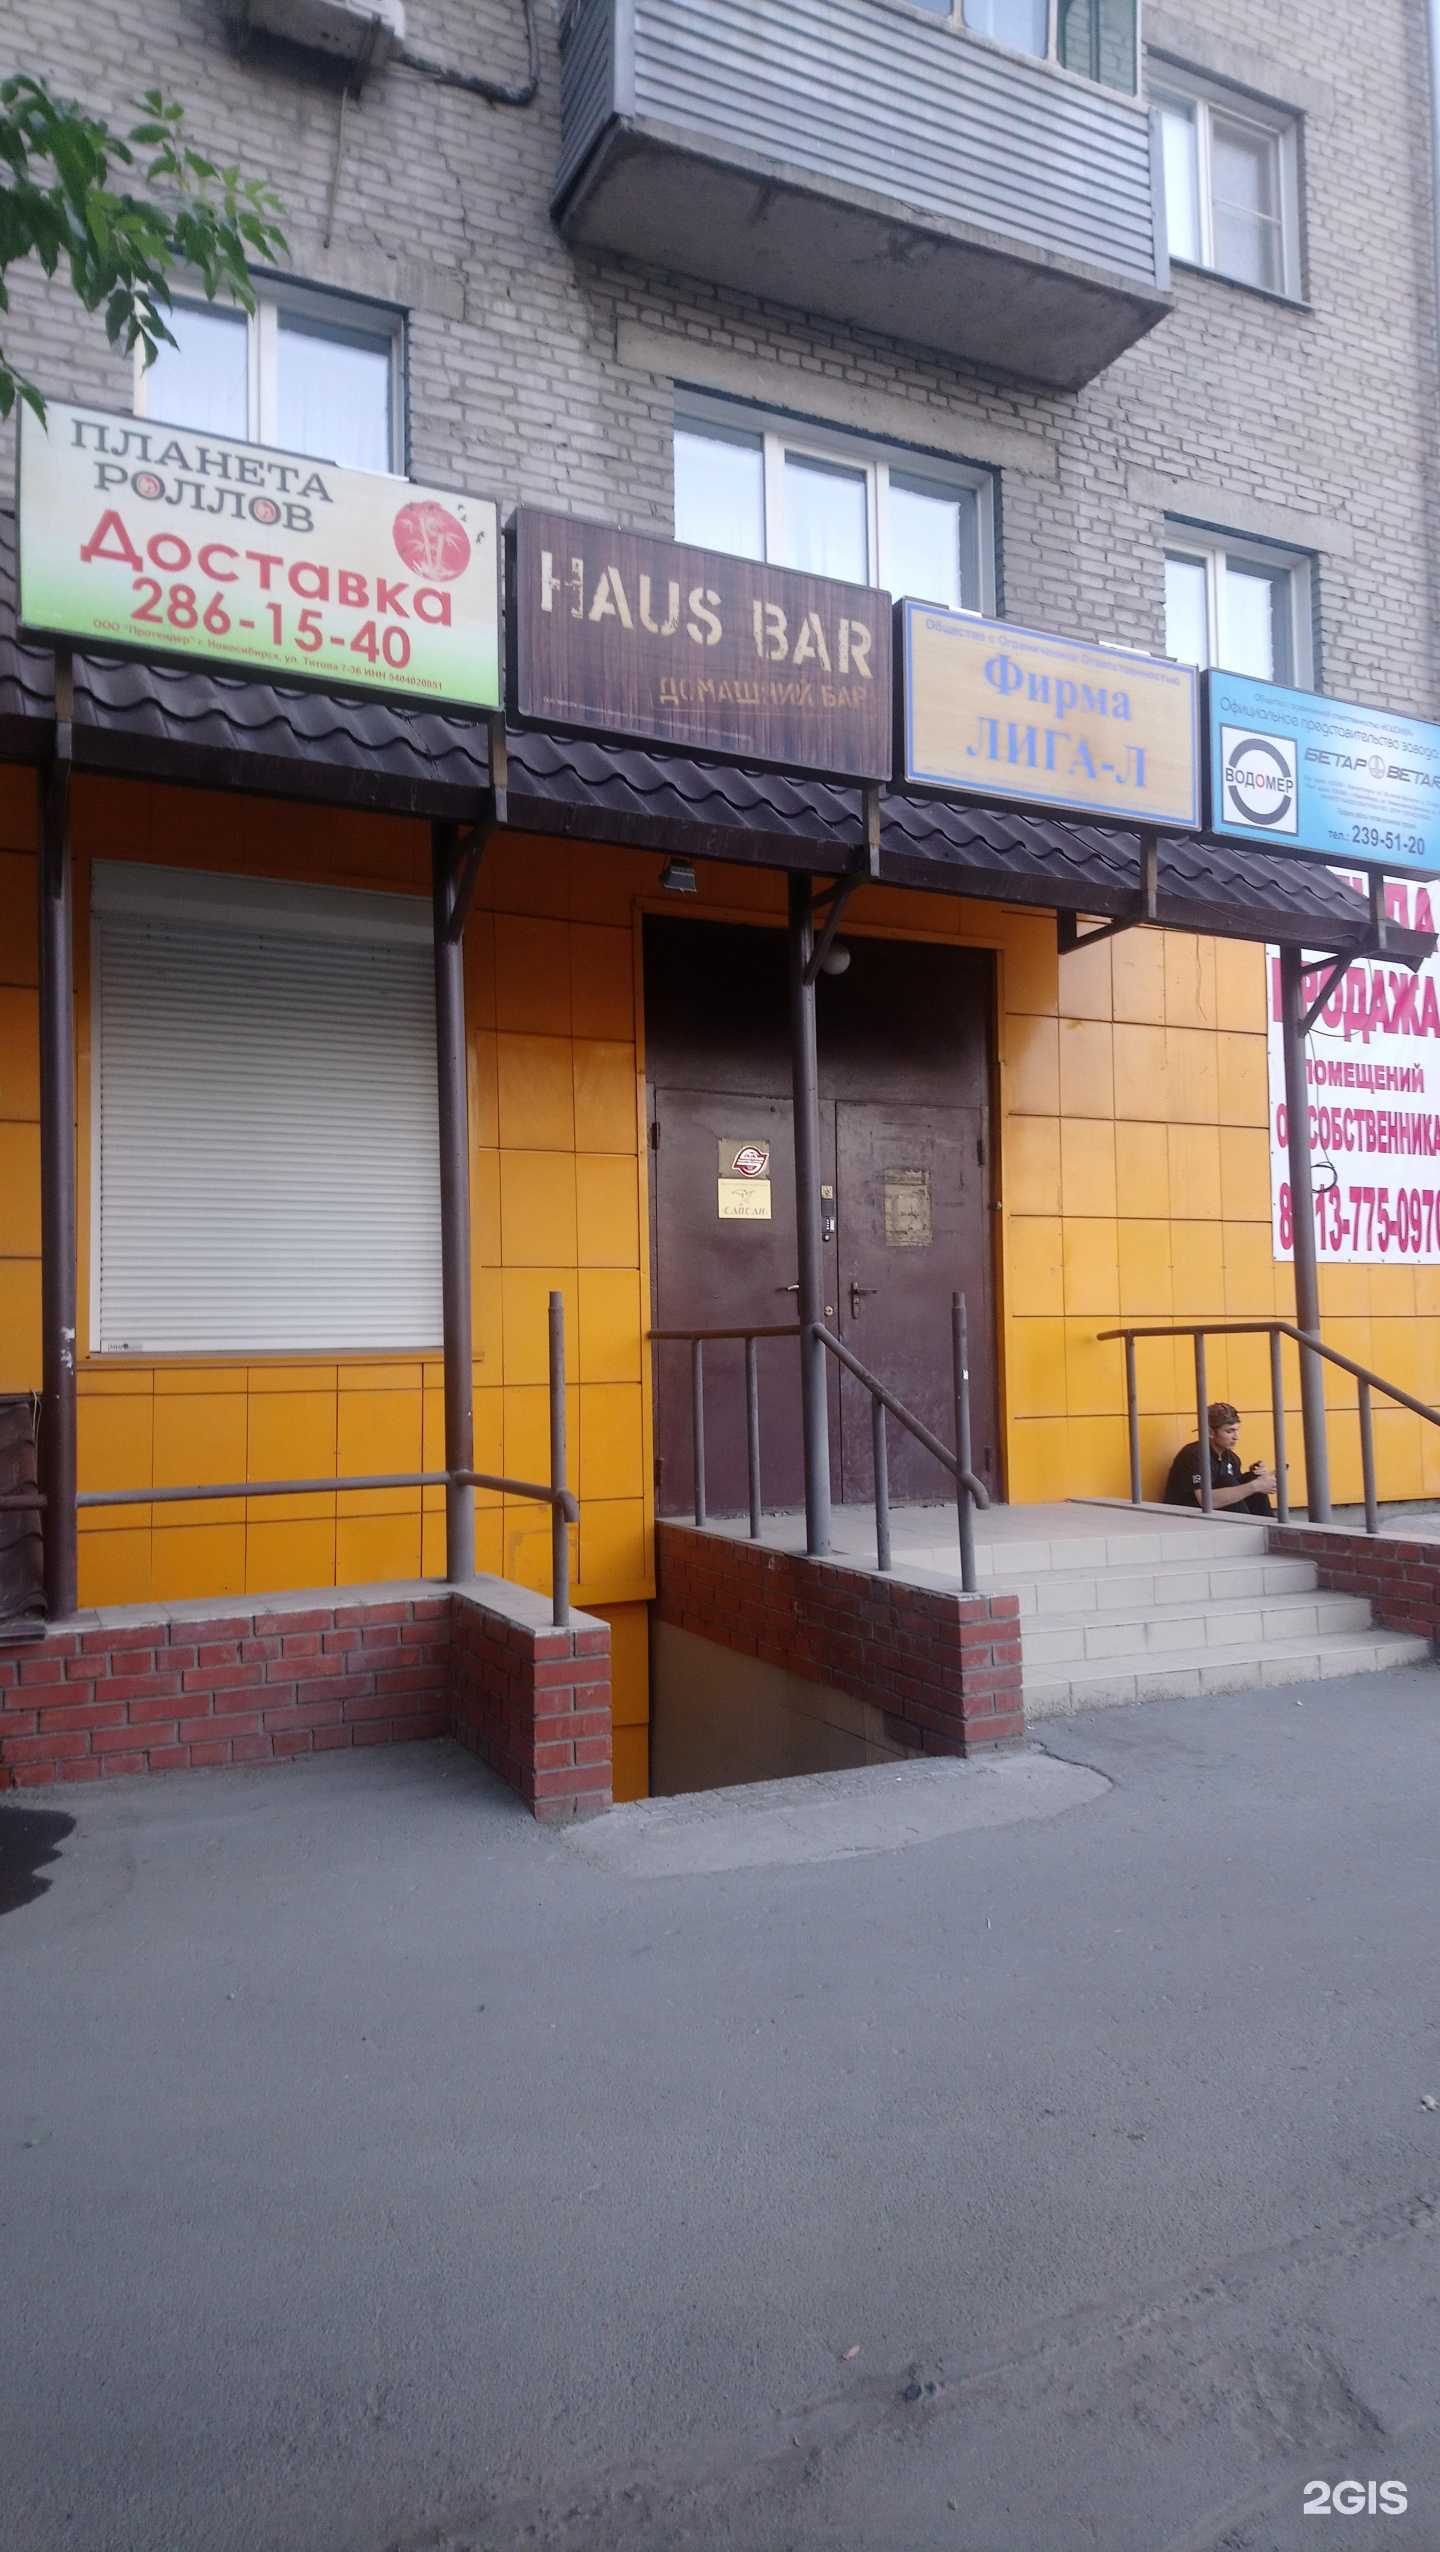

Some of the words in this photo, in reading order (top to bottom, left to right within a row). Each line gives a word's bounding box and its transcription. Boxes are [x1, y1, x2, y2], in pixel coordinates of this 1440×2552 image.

[71, 418, 334, 503] ПЛАНЕТА
[93, 461, 315, 533] РОЛЛОВ
[131, 577, 412, 669] 286-15-40
[540, 550, 723, 646] HAUS
[752, 599, 873, 679] BAR
[820, 685, 868, 708] БАР
[983, 654, 1132, 721] Фирма
[964, 715, 1147, 788] ЛИГА-Л
[1225, 767, 1294, 794] ВОДОМЕР
[1351, 825, 1425, 856] 239-51-20
